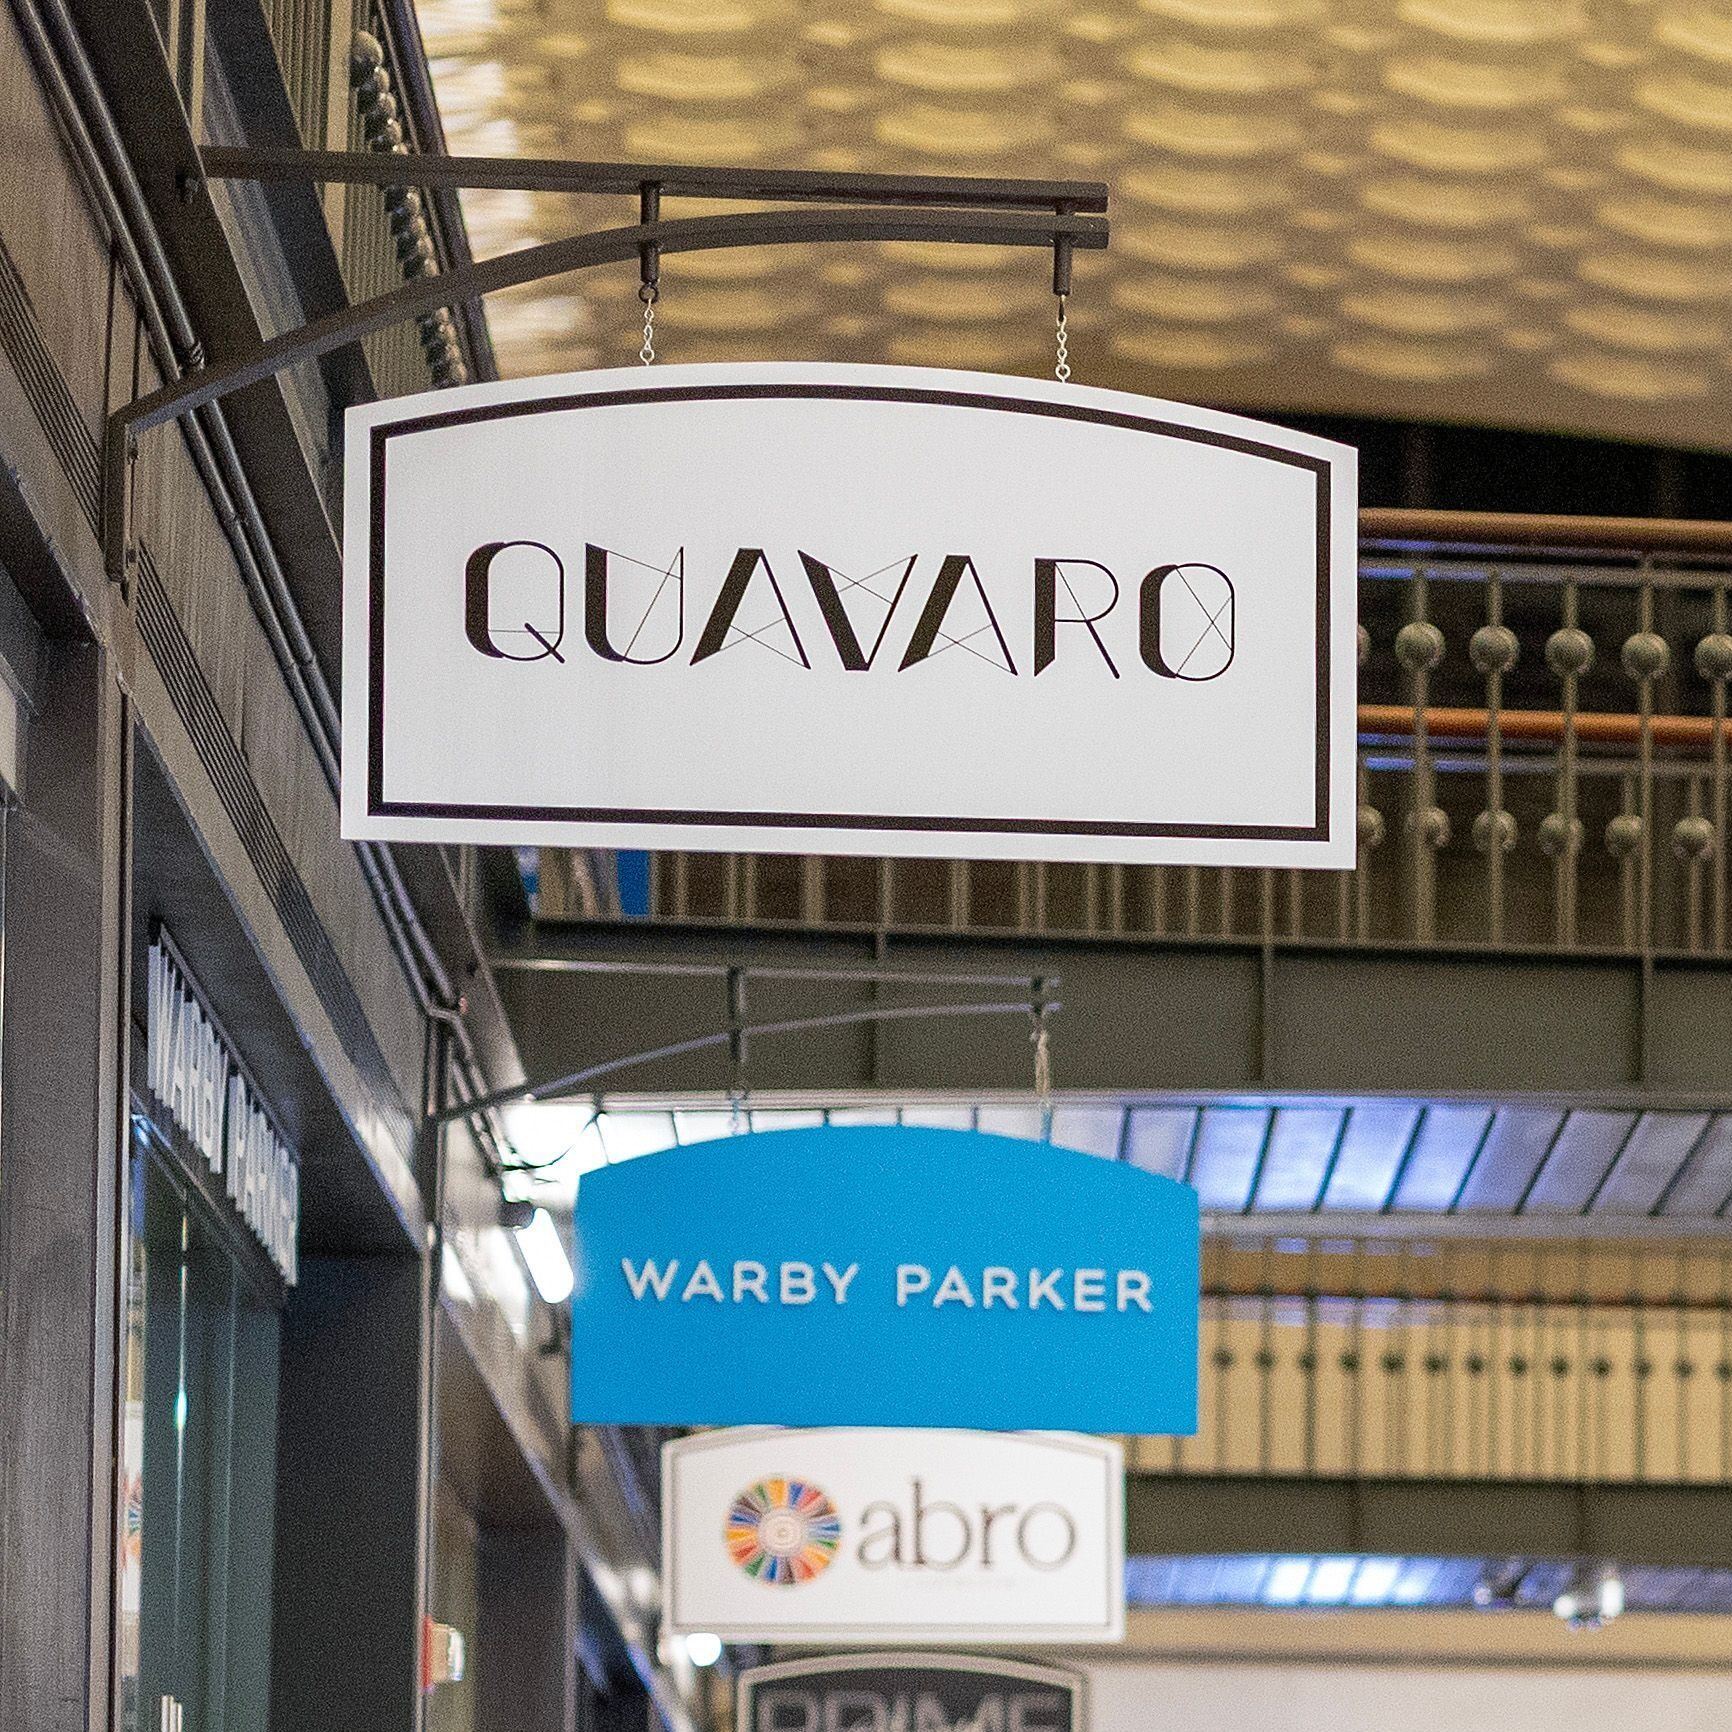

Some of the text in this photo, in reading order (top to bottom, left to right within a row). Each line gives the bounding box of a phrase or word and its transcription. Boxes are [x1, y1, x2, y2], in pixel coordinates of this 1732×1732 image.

[464, 540, 1235, 682] QUAVARO
[621, 1258, 1153, 1312] WARBY PARKER
[855, 1476, 1079, 1571] abro
